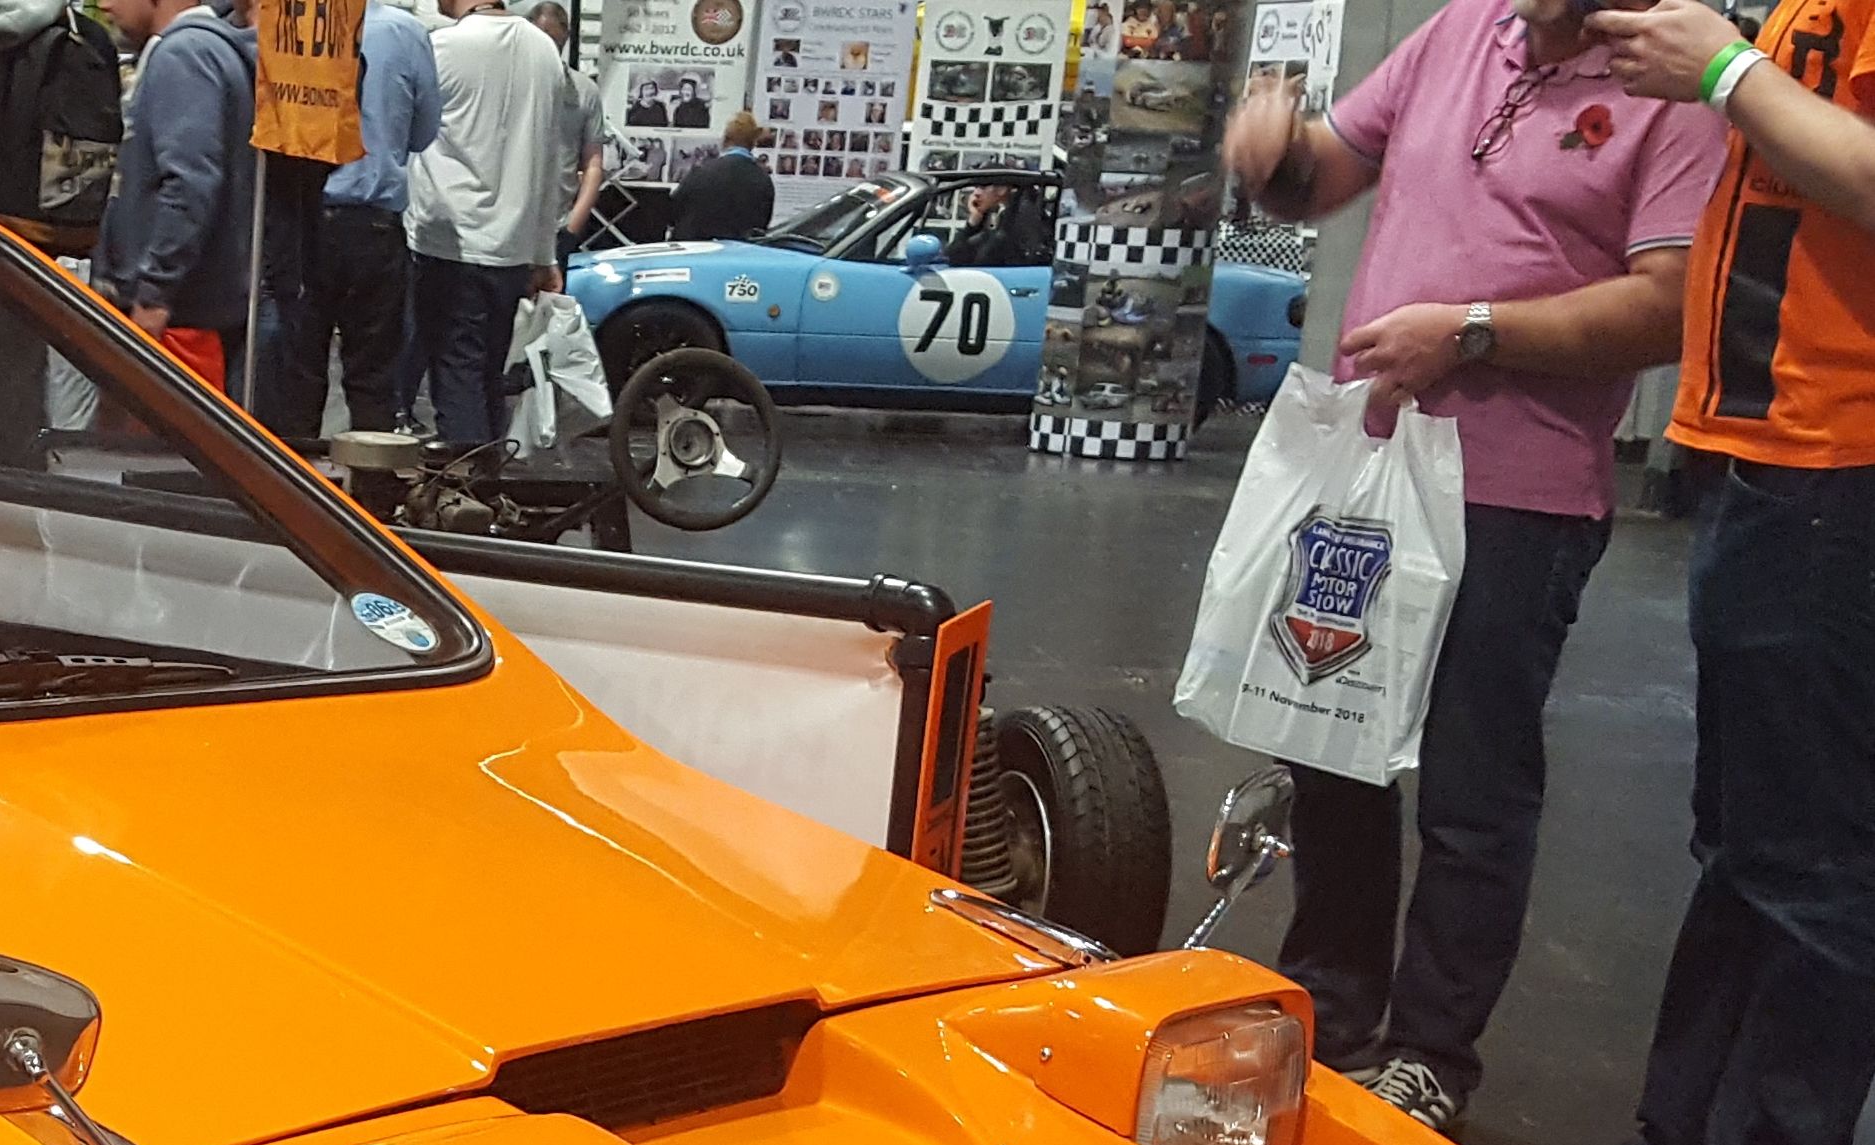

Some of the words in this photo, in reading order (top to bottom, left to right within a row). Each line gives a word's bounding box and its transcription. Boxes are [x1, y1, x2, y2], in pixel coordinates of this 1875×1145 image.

[604, 40, 745, 58] www.bwrdc.co.uk
[727, 283, 758, 298] 750
[913, 289, 992, 356] 70
[1269, 690, 1332, 716] November
[1334, 707, 1365, 724] 2018
